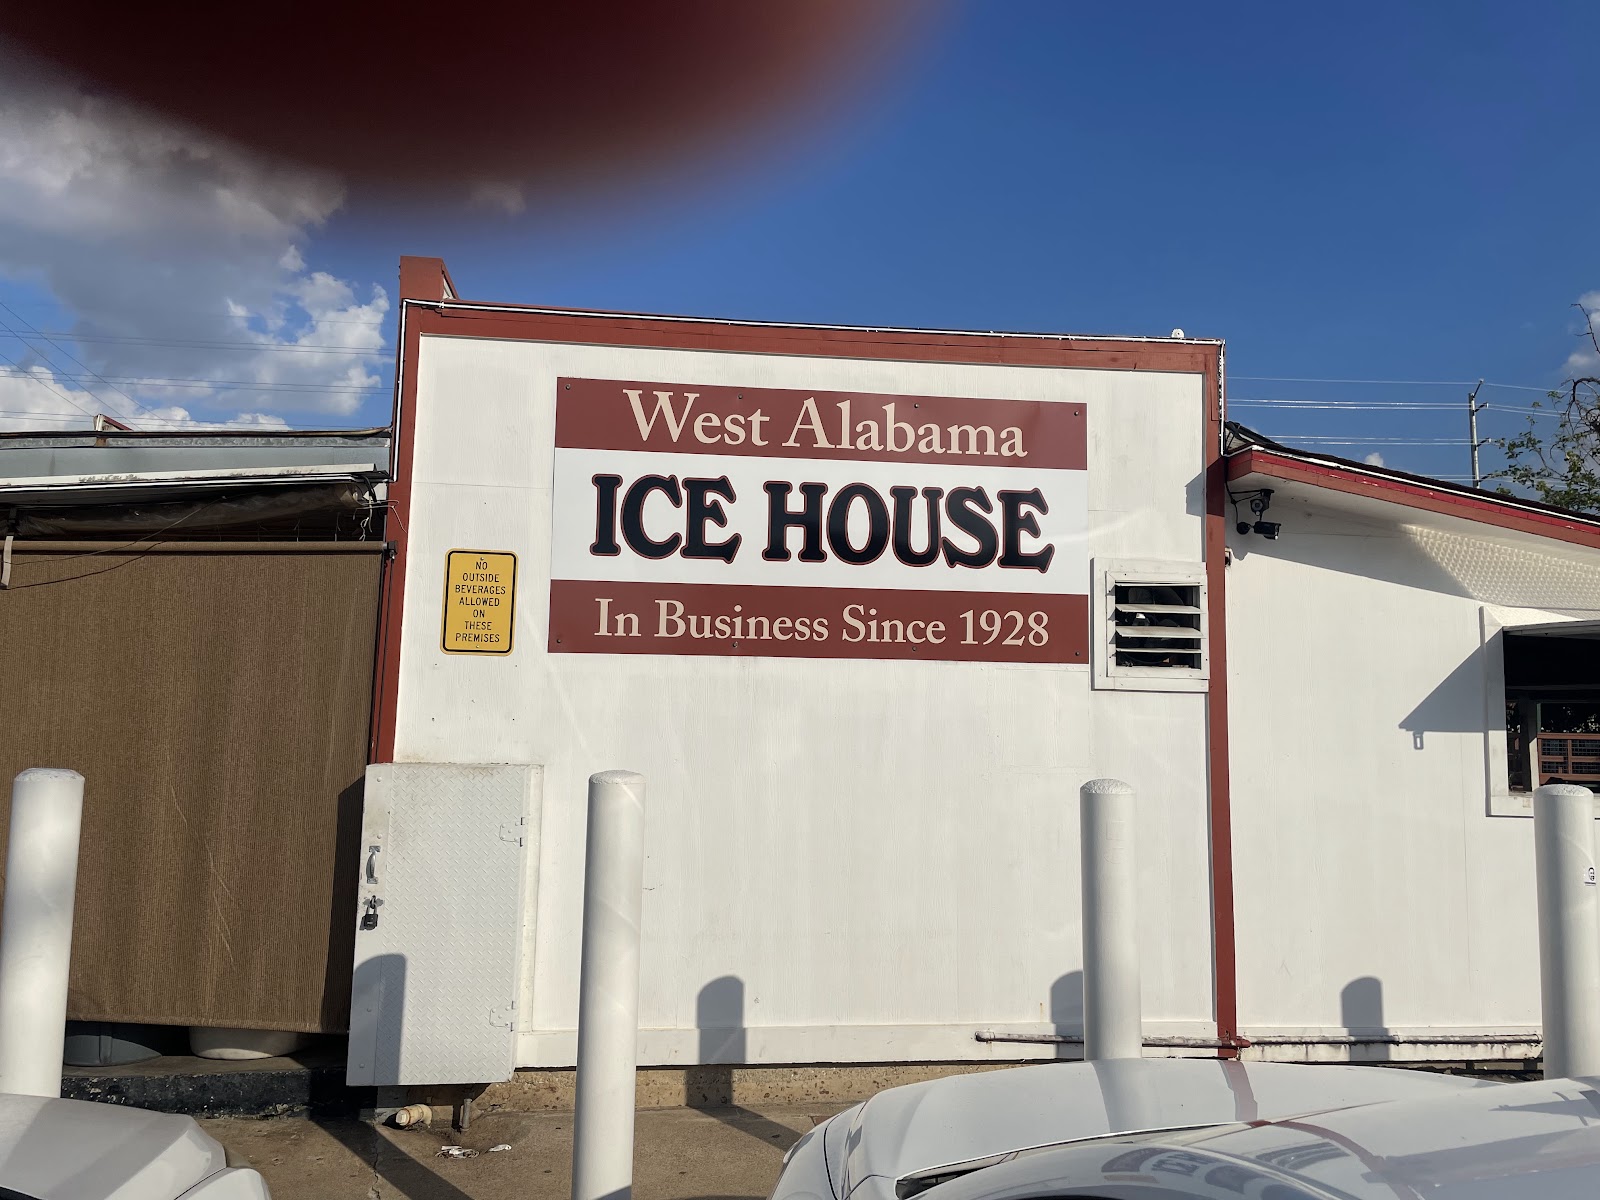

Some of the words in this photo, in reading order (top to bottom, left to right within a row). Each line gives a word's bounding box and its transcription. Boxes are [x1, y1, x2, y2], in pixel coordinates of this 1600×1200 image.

[622, 388, 770, 446] West
[781, 397, 1028, 458] Alabama
[589, 473, 742, 564] ICE
[761, 481, 1055, 574] HOUSE
[475, 561, 488, 570] NO
[462, 573, 500, 582] OUTSIDE
[455, 584, 506, 595] BEVERAGES
[459, 597, 500, 606] ALLOWED
[472, 609, 485, 618] ON
[465, 621, 492, 630] THESE
[594, 598, 641, 638] In
[654, 599, 829, 642] Business
[841, 604, 946, 645] Since
[959, 609, 1050, 647] 1928
[455, 633, 500, 642] PREMISES
